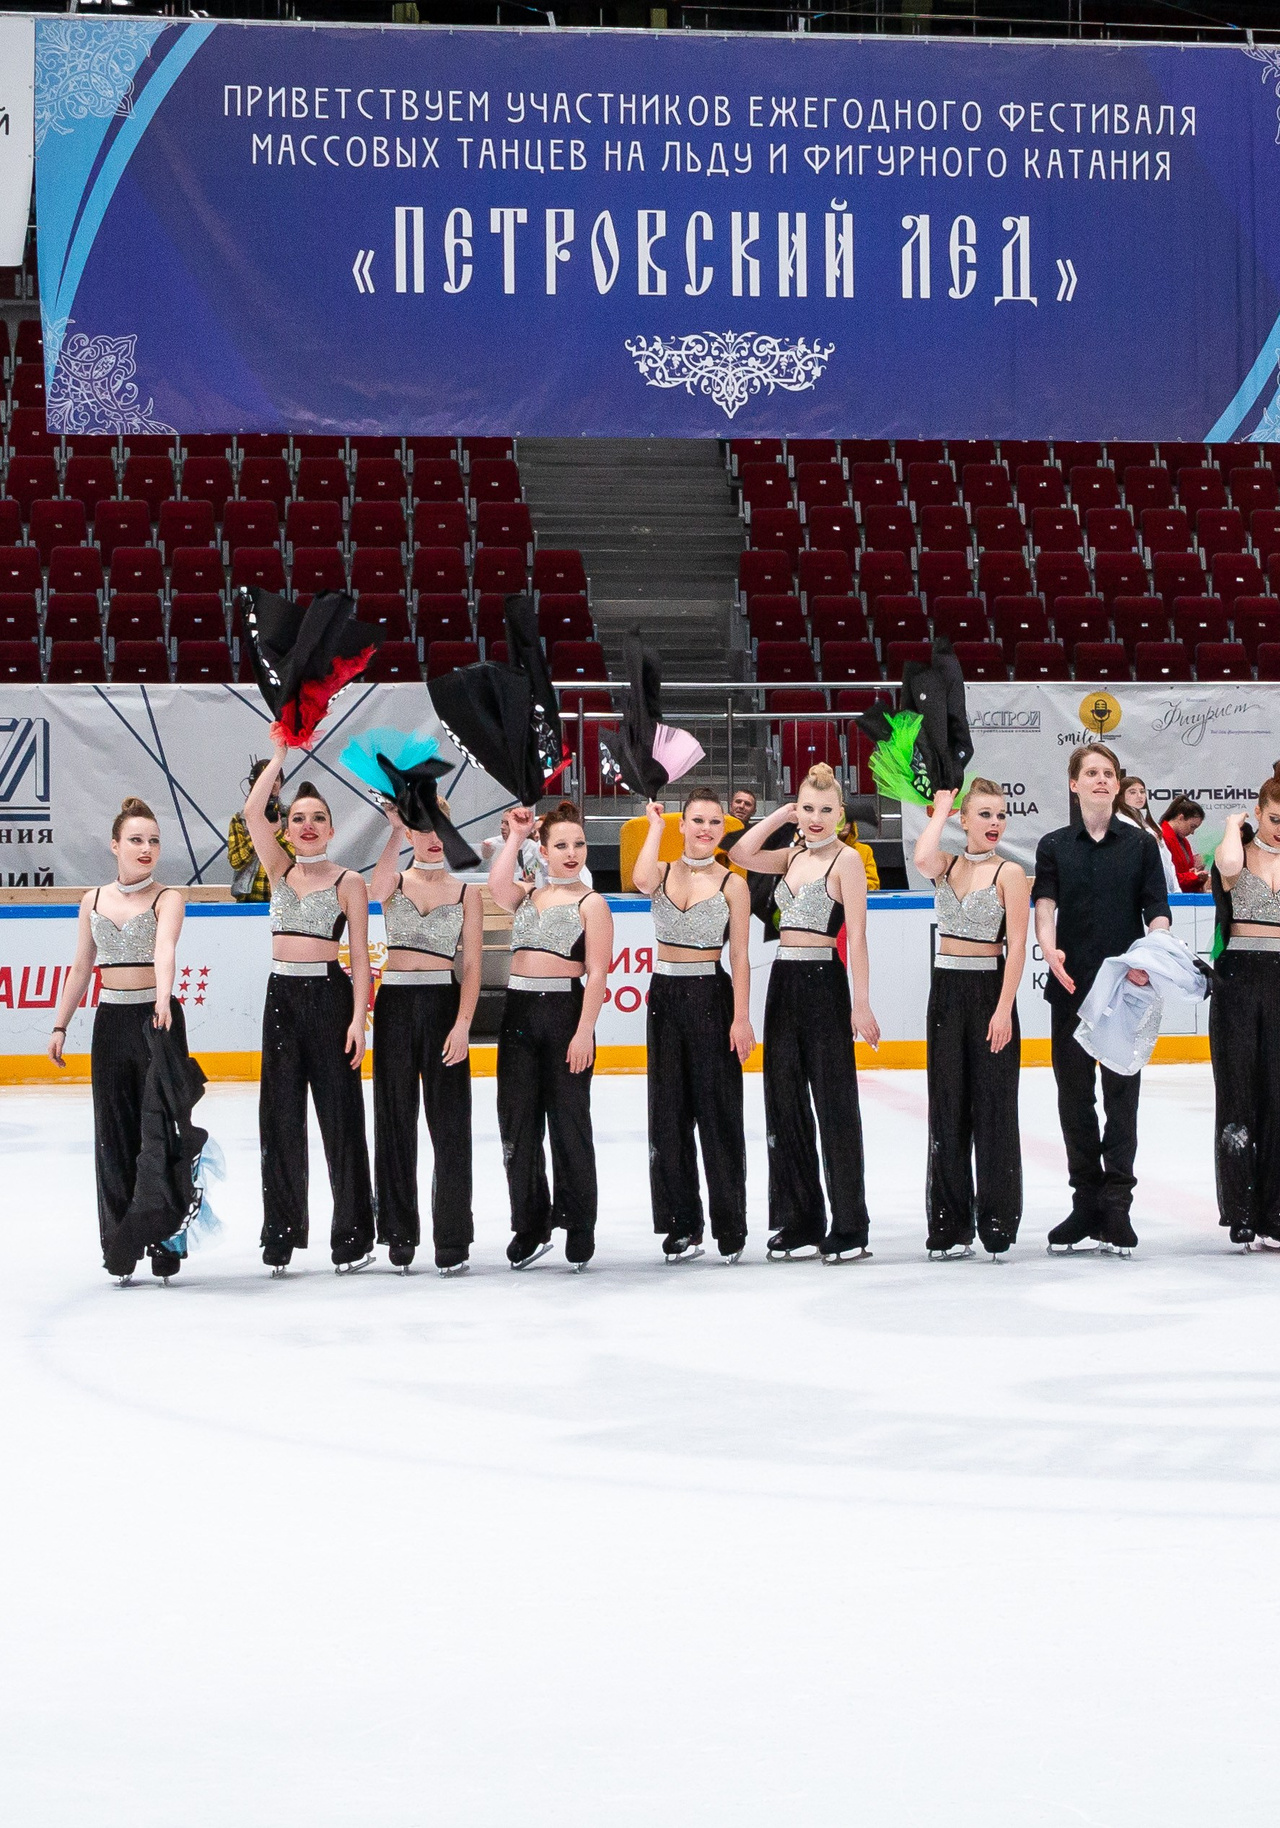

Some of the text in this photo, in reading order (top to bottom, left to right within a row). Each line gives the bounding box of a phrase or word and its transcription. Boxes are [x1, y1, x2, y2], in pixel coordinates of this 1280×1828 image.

[224, 85, 1196, 136] ПРИВЕТСТВУЕМ УЧАСТНИКОВ ЕЖЕГОДНОГО ФЕСТИВАЛЯ
[252, 133, 1170, 181] МАССОВЫХ ТАНЦЕВ НА ЛЬДУ И ФИГУРНОГО КАТАНИЯ
[1057, 727, 1096, 746] smile
[1148, 785, 1260, 800] ЮБИЛЕЙНЫ
